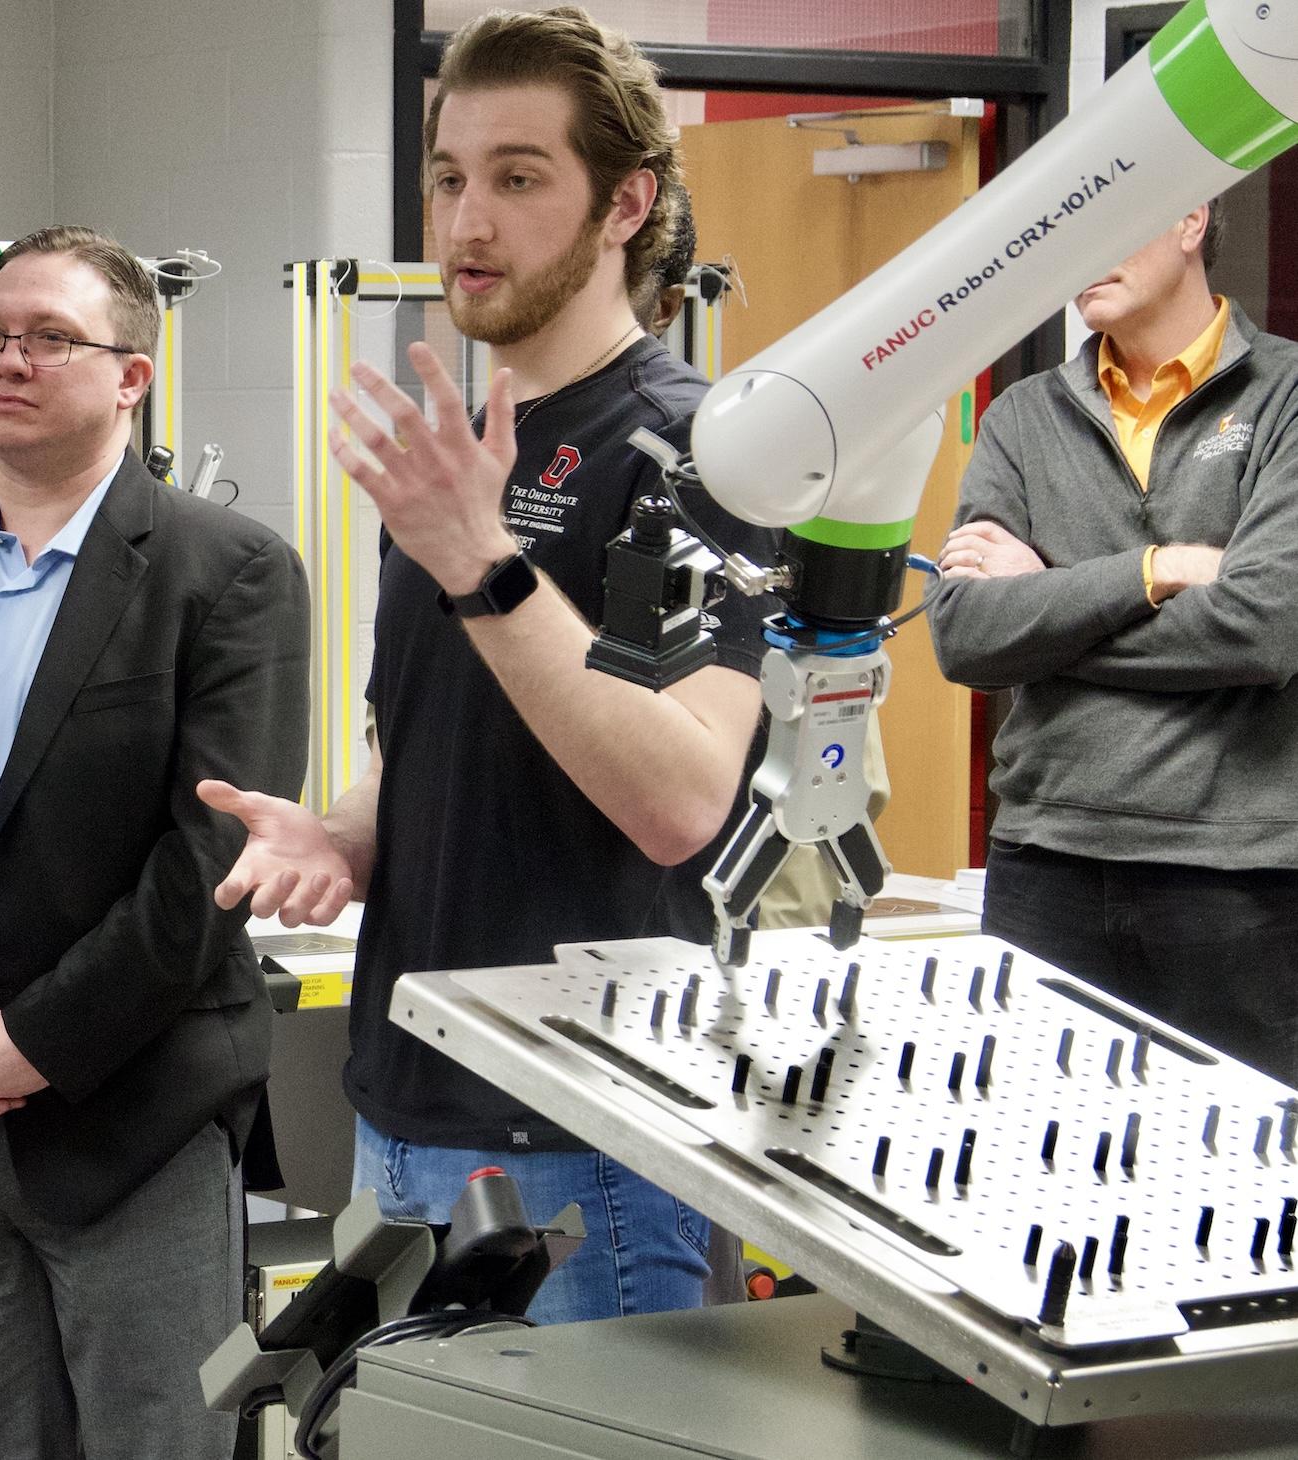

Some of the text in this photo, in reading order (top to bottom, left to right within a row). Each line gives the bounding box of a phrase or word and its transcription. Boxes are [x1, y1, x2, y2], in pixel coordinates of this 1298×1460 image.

[861, 157, 1136, 370] FANUC Robot CRX-10iA/L
[1201, 441, 1244, 461] PRACTICE
[528, 488, 551, 502] OHIO
[550, 493, 579, 506] STATE
[511, 499, 565, 517] UNIVERSITY
[273, 1278, 300, 1287] FANUC
